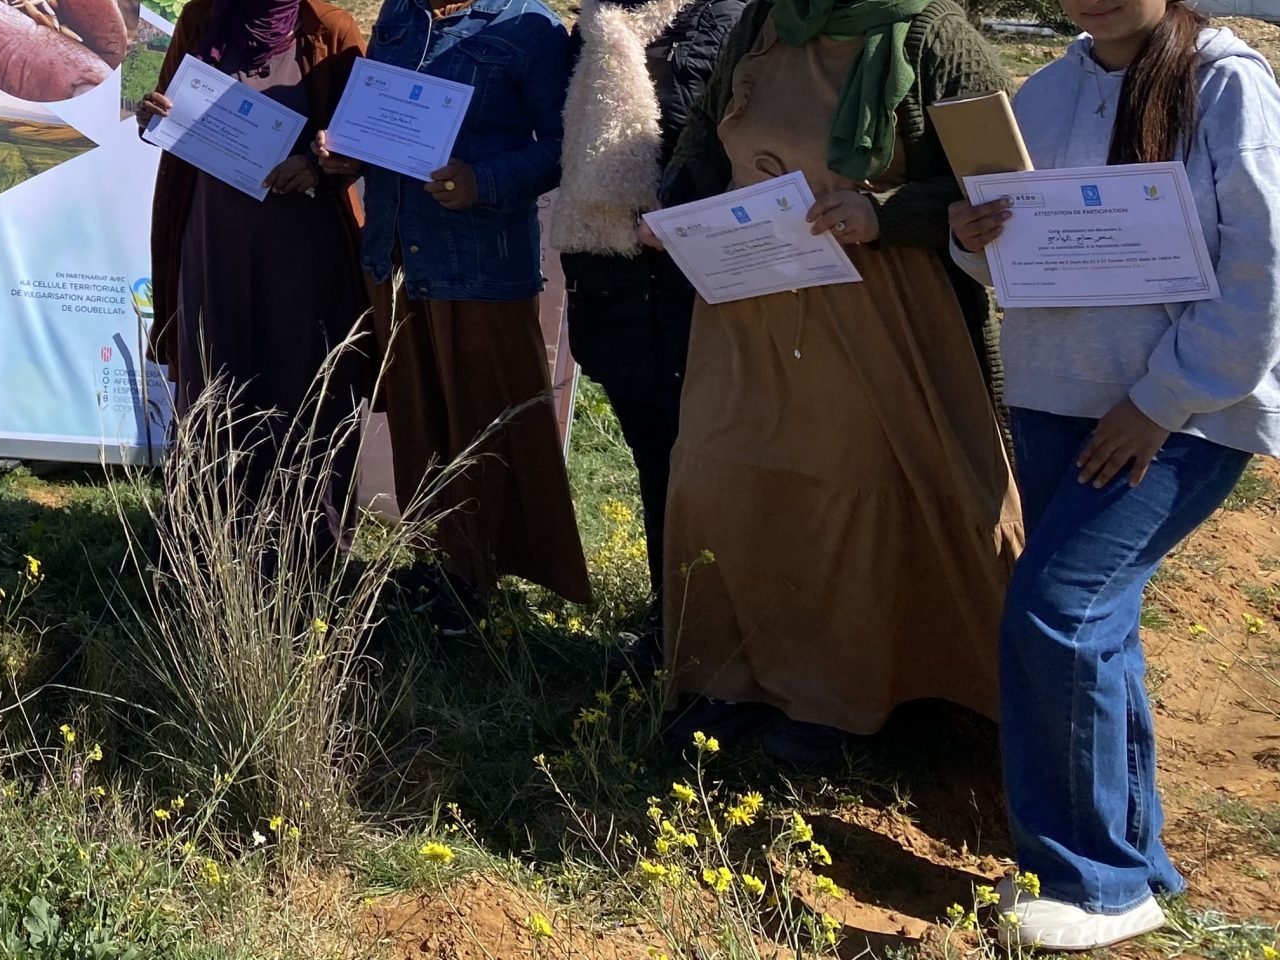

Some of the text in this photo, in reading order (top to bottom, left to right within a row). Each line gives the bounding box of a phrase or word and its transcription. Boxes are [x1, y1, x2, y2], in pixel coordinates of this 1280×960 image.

[55, 271, 65, 279] EN
[66, 272, 108, 281] PARTENARIAT
[32, 280, 67, 289] CELLULE
[69, 282, 126, 294] TERRITORIALE
[23, 290, 83, 301] VULGARISATION
[85, 295, 125, 304] AGRICOLE
[61, 304, 73, 312] DE
